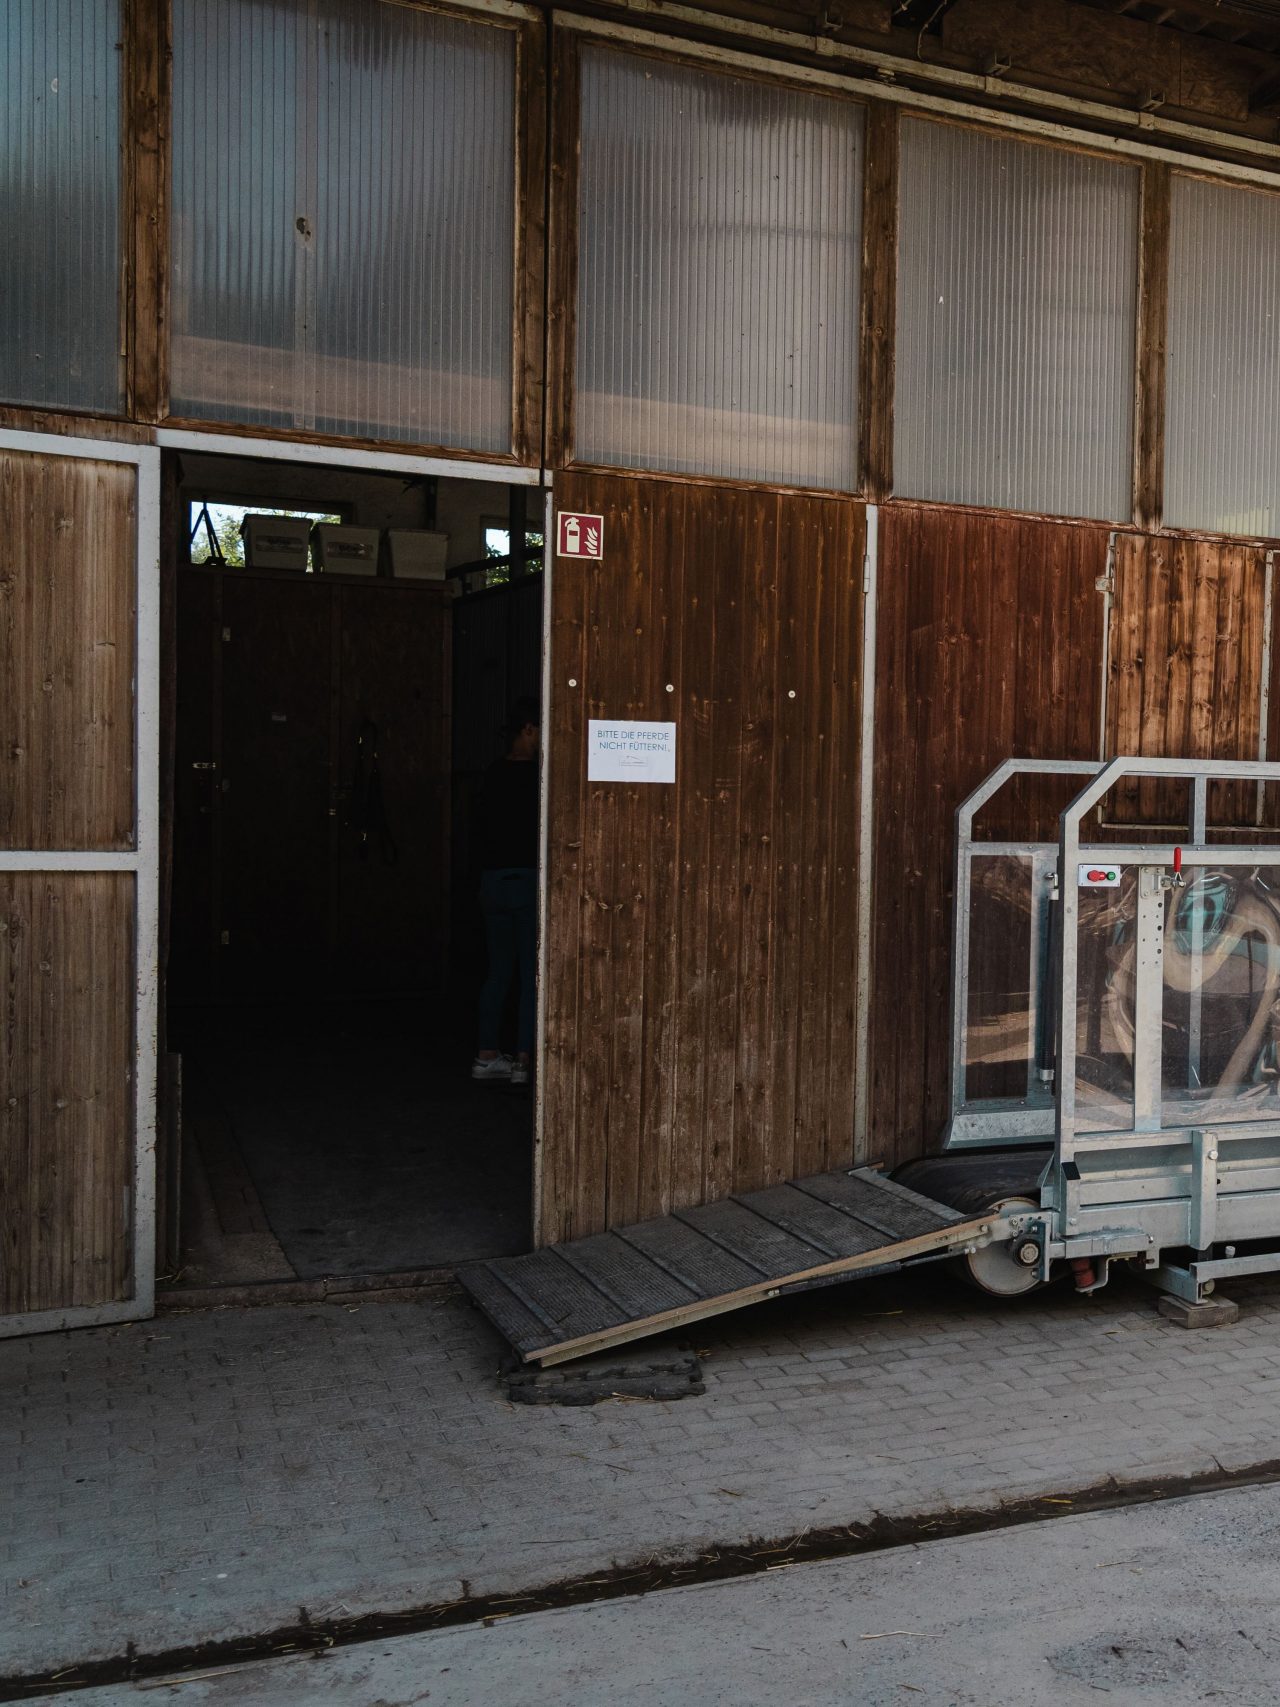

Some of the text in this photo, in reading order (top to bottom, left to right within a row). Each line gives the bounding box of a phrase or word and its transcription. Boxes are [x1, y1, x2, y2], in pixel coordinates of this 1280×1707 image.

[597, 730, 669, 741] BITTE DIE PFERDE
[599, 741, 667, 752] NICHT FÜTTERN!
